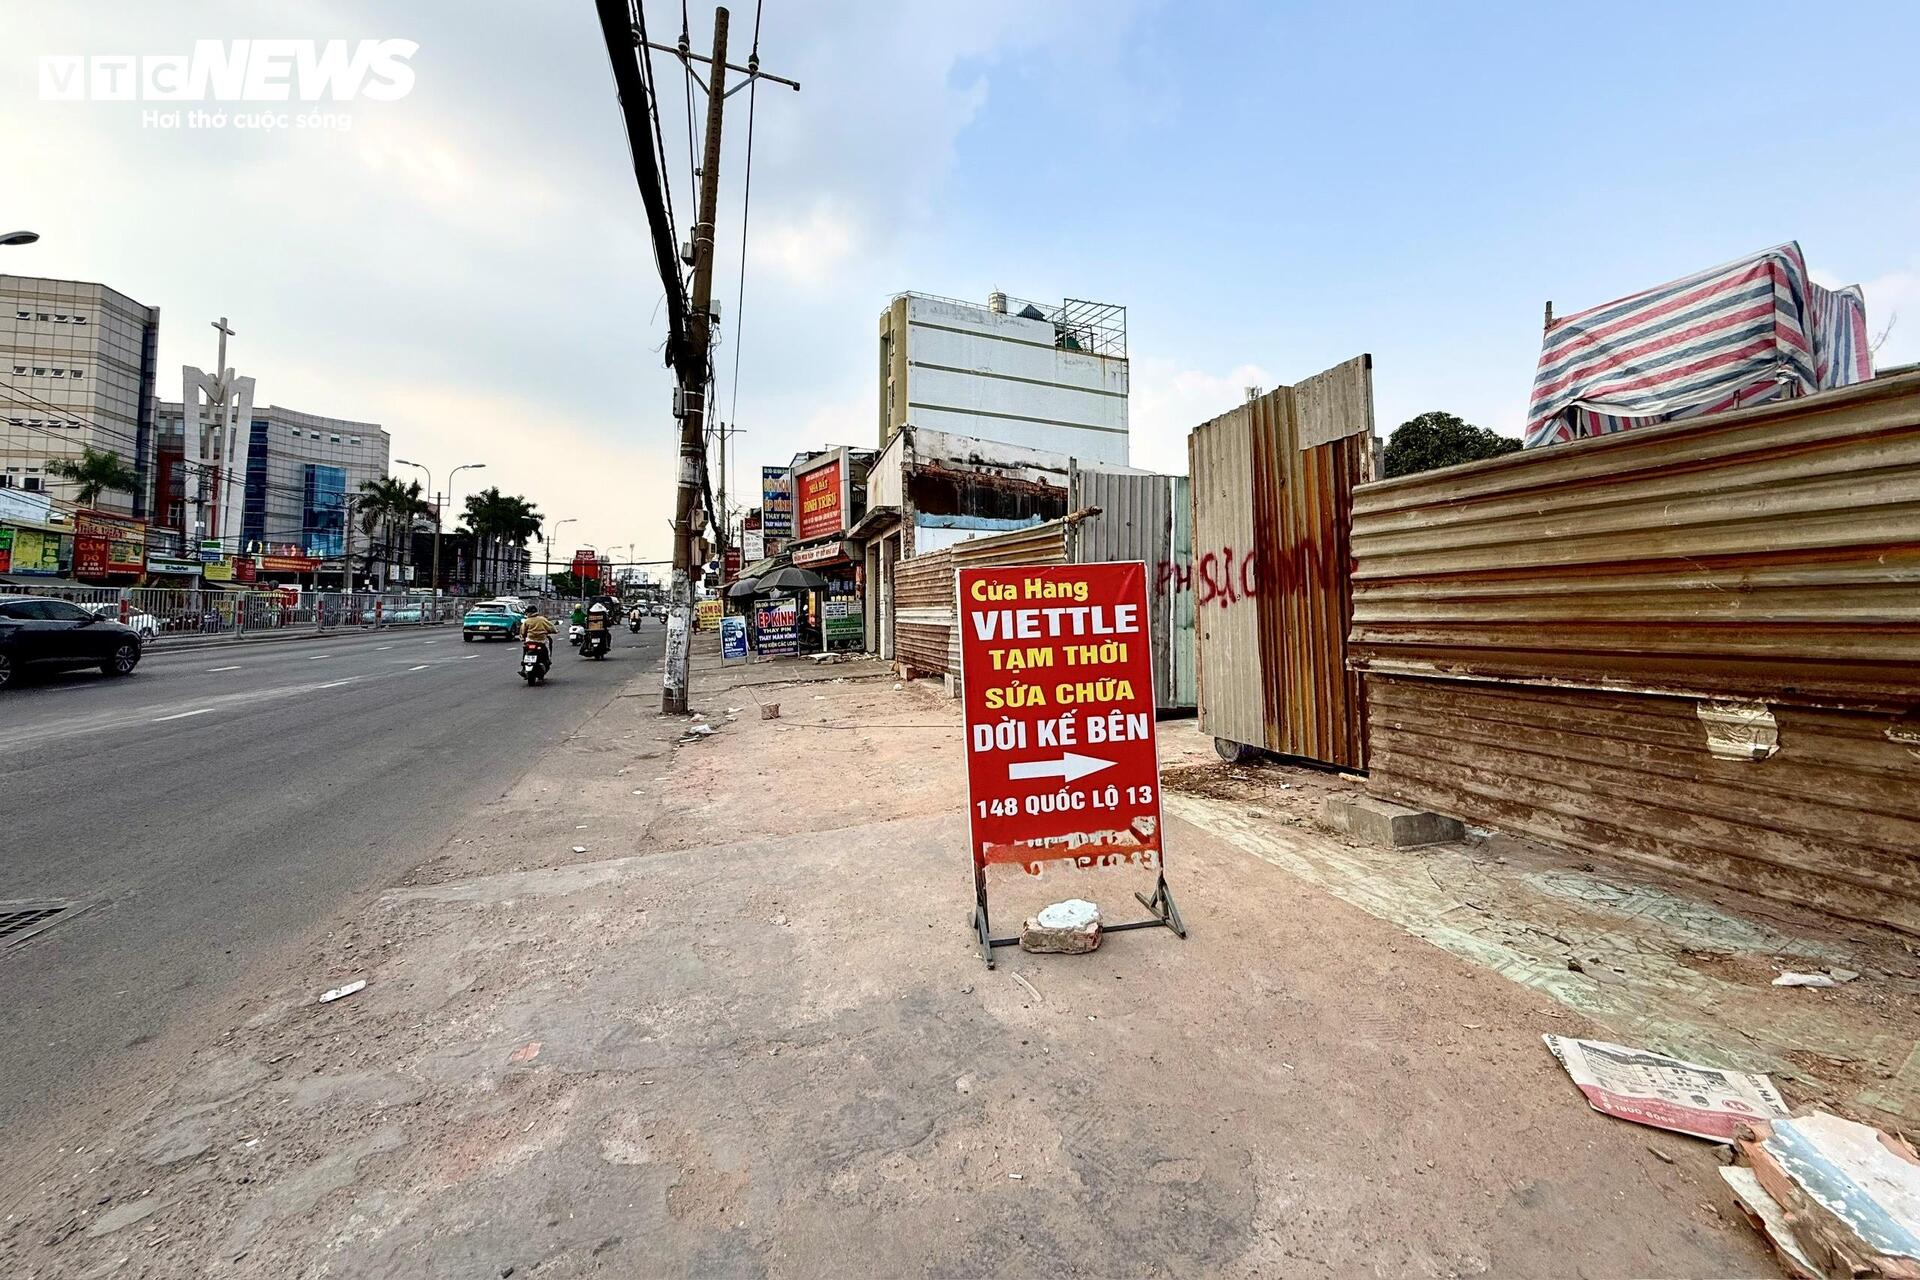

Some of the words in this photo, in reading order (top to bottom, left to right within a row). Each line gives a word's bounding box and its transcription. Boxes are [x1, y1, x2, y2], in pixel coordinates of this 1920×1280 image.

[971, 580, 1018, 601] Cửa
[1024, 578, 1088, 601] Hàng
[771, 608, 796, 627] KÍNH
[971, 604, 1139, 641] VIETTLE
[989, 647, 1053, 673] TẠM
[1063, 639, 1128, 665] THỜI
[985, 680, 1046, 709] SỬA
[1056, 677, 1135, 704] CHỮA
[973, 715, 1027, 752] DỜI
[1038, 708, 1078, 747] KẾ
[1087, 710, 1149, 743] BÊN
[976, 797, 1018, 818] 148
[1025, 786, 1086, 815] QUỐC
[1093, 785, 1118, 811] LỘ
[1126, 785, 1152, 805] 13
